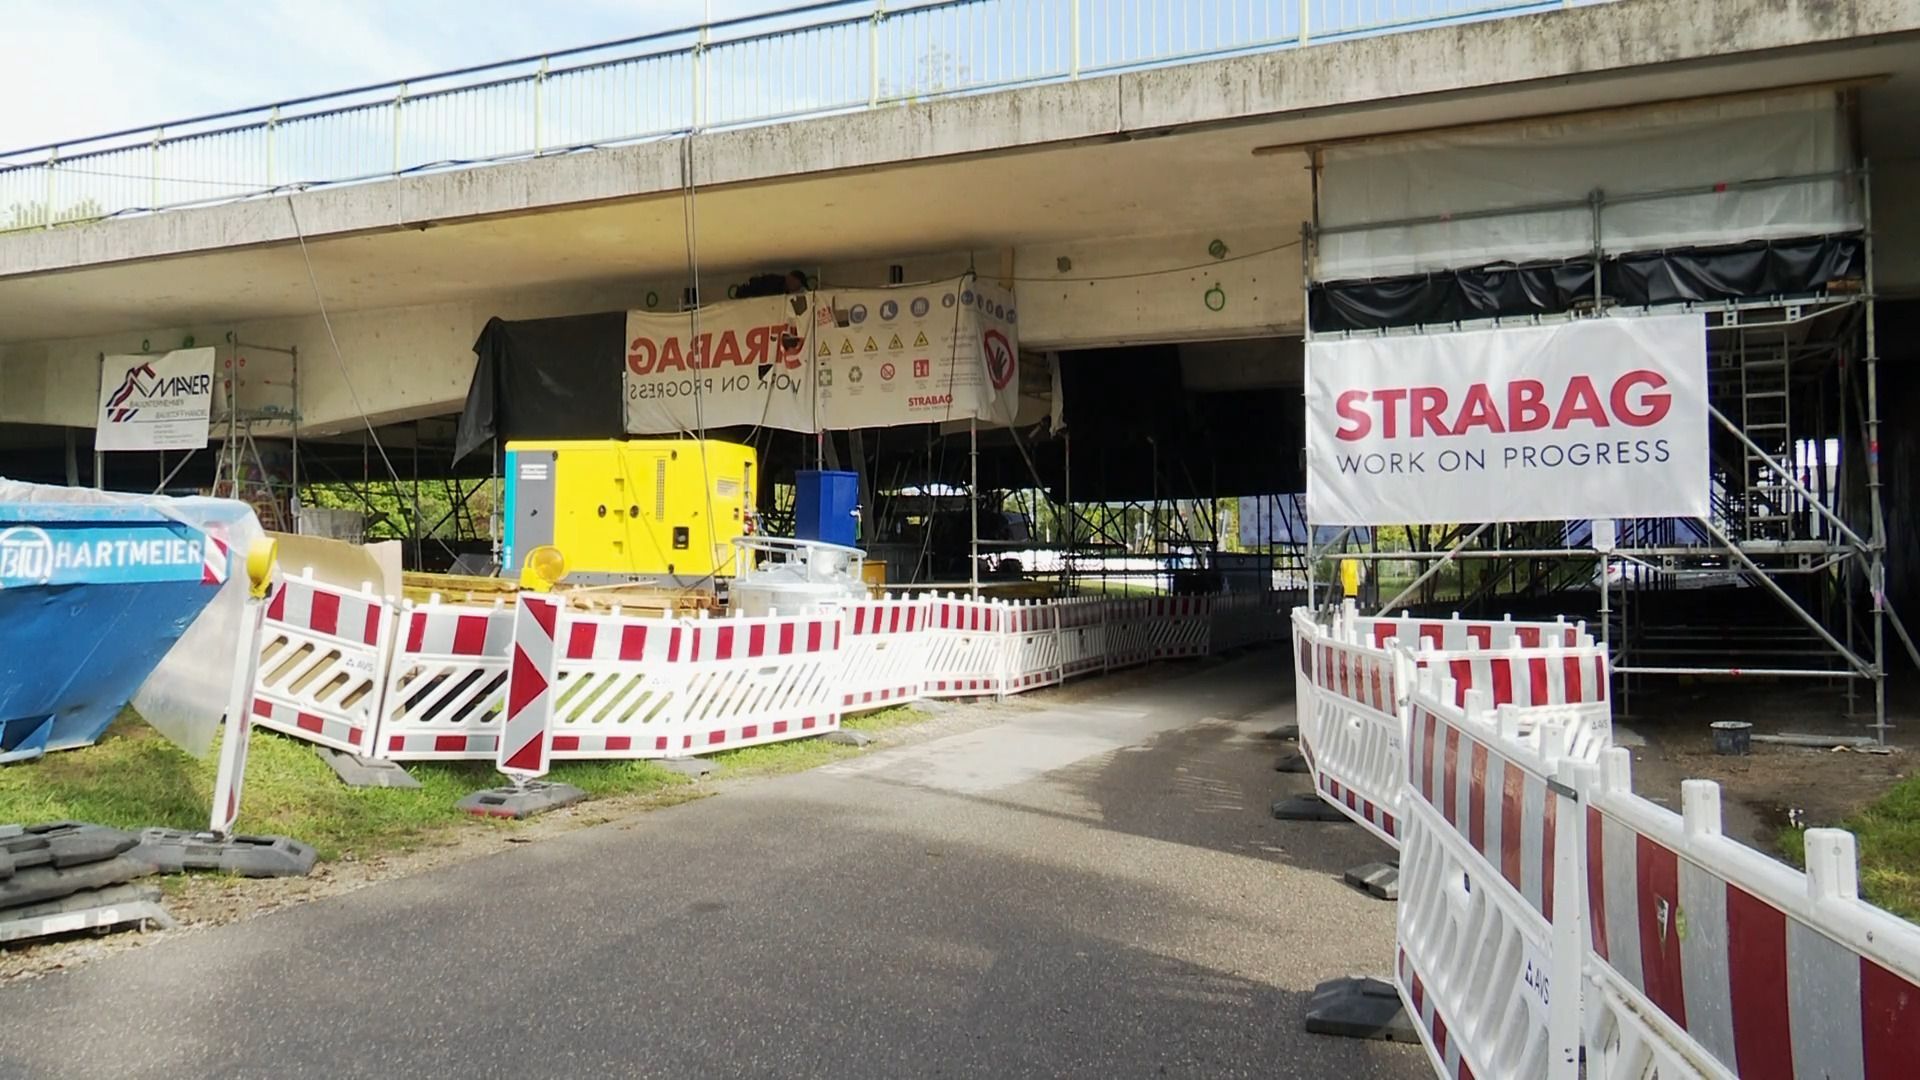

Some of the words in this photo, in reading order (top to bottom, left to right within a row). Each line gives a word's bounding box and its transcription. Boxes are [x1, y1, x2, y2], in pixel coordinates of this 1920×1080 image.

[148, 374, 210, 398] MAYER
[908, 394, 953, 407] STRABAG
[1335, 369, 1672, 441] STRABAG
[1336, 450, 1426, 475] WORK
[1439, 449, 1485, 473] ON
[1504, 440, 1670, 469] PROGRESS
[55, 538, 202, 568] HARTMEIER
[1534, 968, 1550, 1005] AVS
